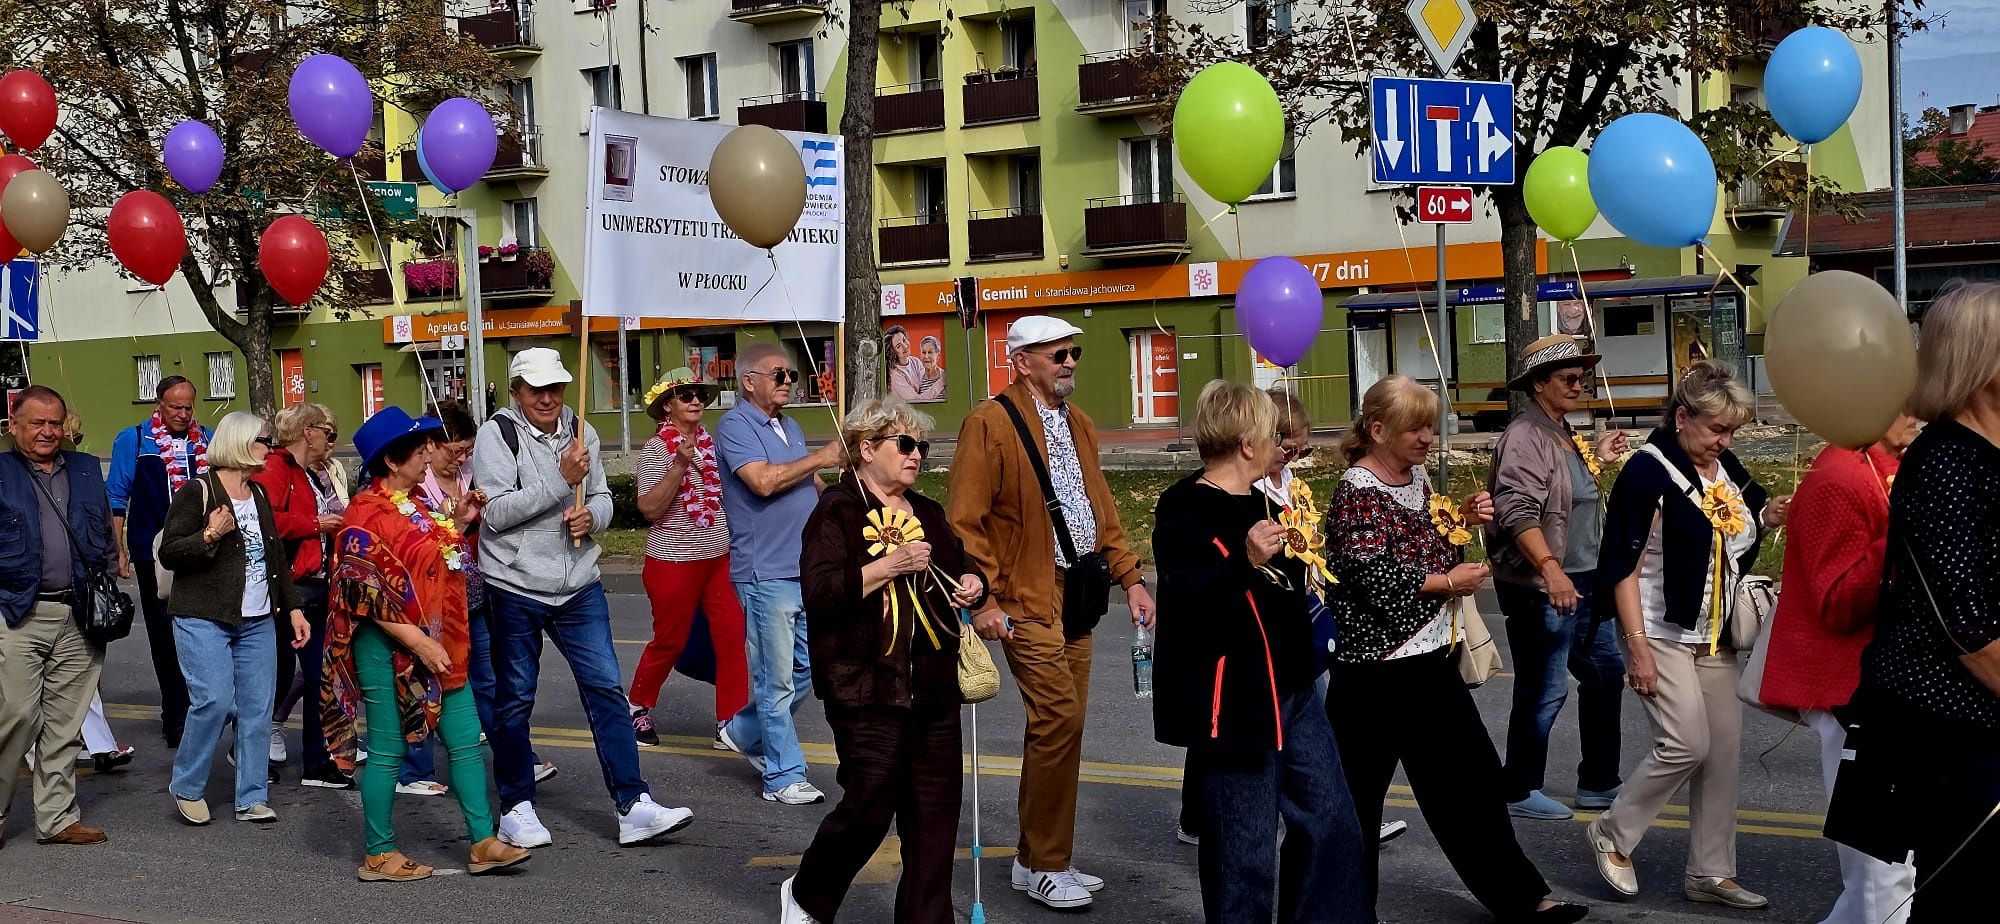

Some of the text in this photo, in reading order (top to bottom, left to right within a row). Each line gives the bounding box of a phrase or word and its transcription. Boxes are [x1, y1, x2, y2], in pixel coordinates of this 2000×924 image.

[659, 165, 709, 186] STOWA
[369, 185, 402, 197] anów
[804, 202, 838, 210] OWIECKA
[1427, 194, 1446, 215] 60
[602, 213, 709, 238] UNIWERSYTETU
[787, 226, 839, 245] WIEKU
[1336, 258, 1369, 281] dni
[678, 272, 748, 291] W PŁOCKU
[982, 285, 1028, 302] Gemini
[1089, 283, 1135, 297] Jachowicza
